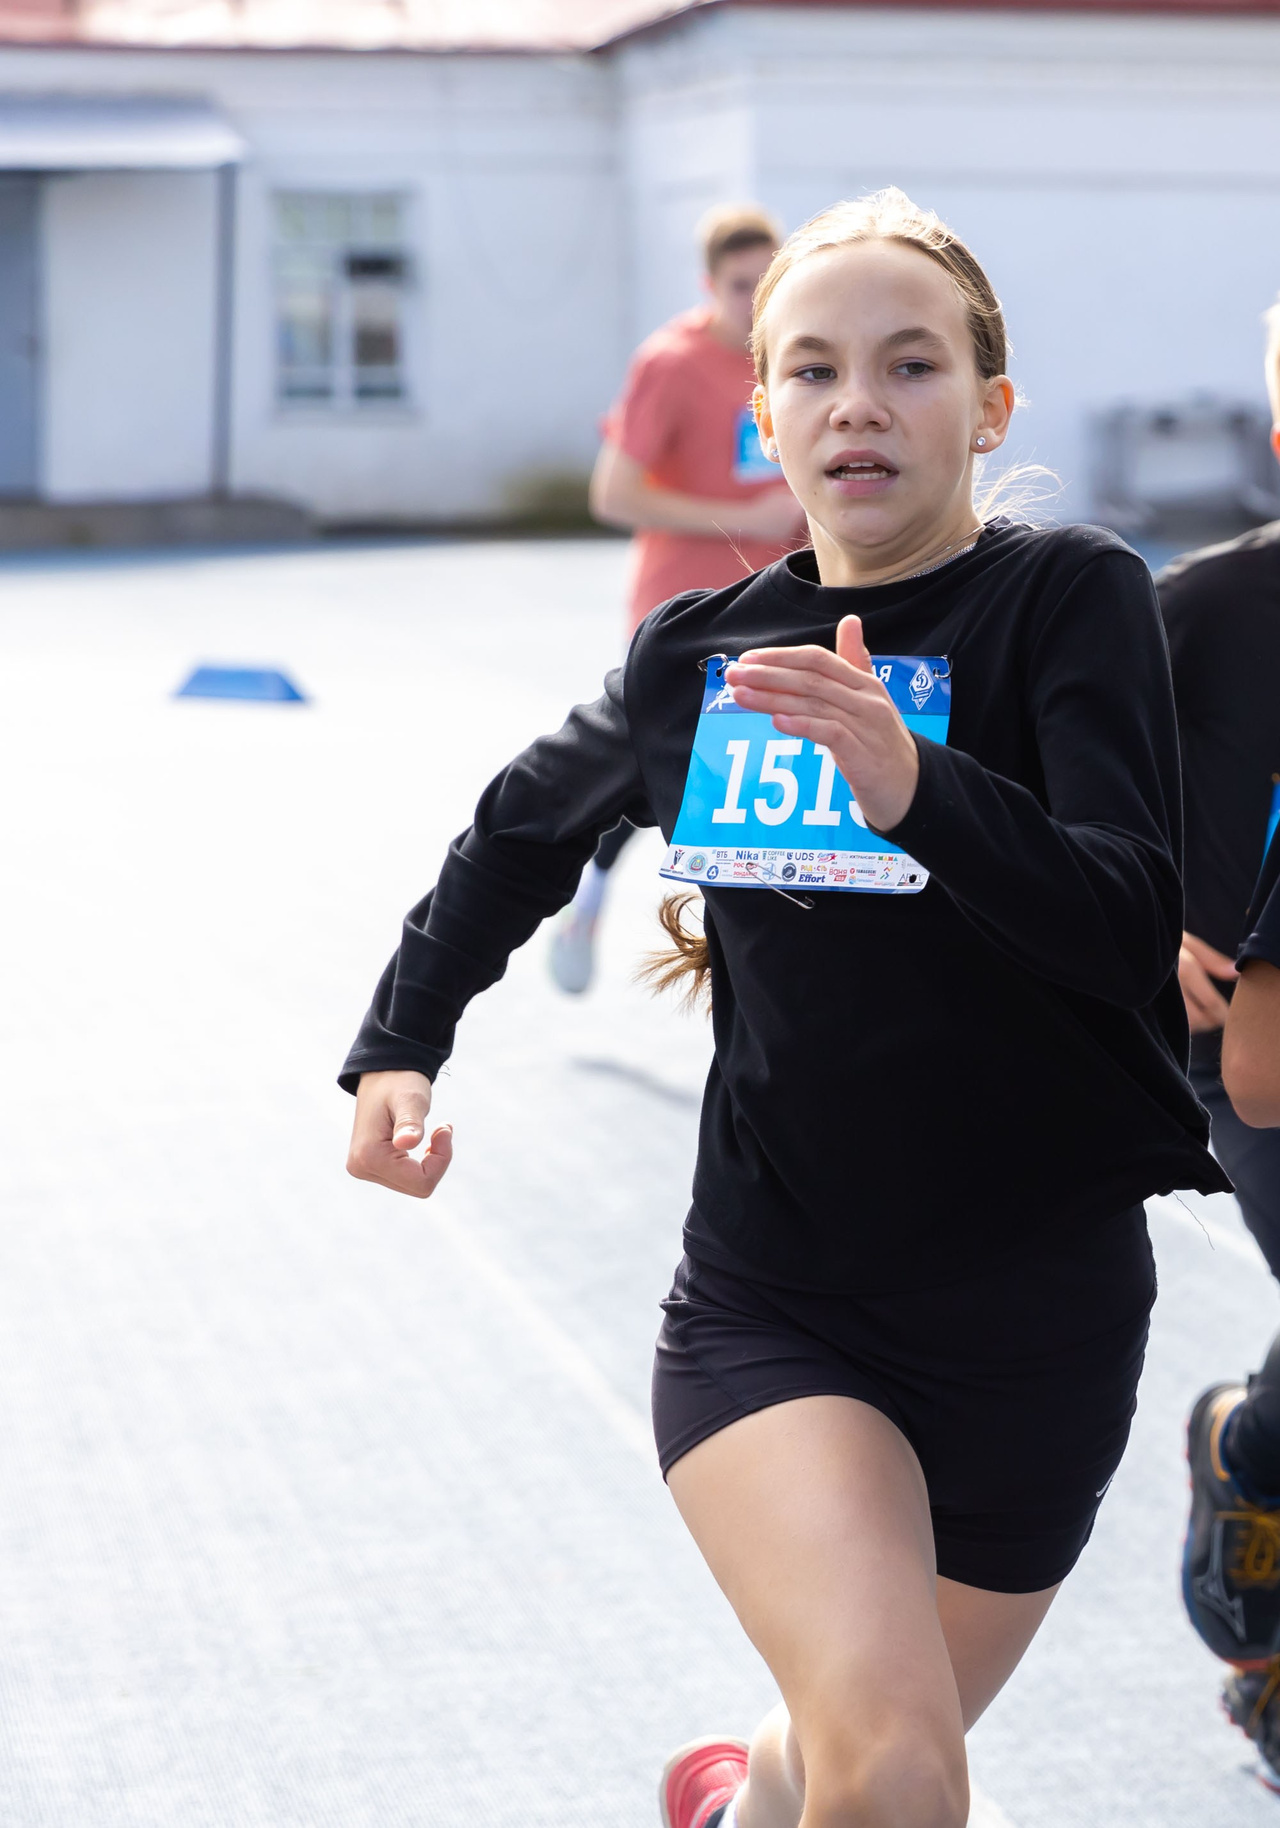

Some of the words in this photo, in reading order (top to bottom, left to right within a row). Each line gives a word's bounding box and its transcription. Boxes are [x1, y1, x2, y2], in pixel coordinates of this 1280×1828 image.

[711, 739, 869, 828] 151
[735, 850, 759, 860] Nika
[795, 852, 815, 861] UDS
[798, 873, 826, 883] Effort
